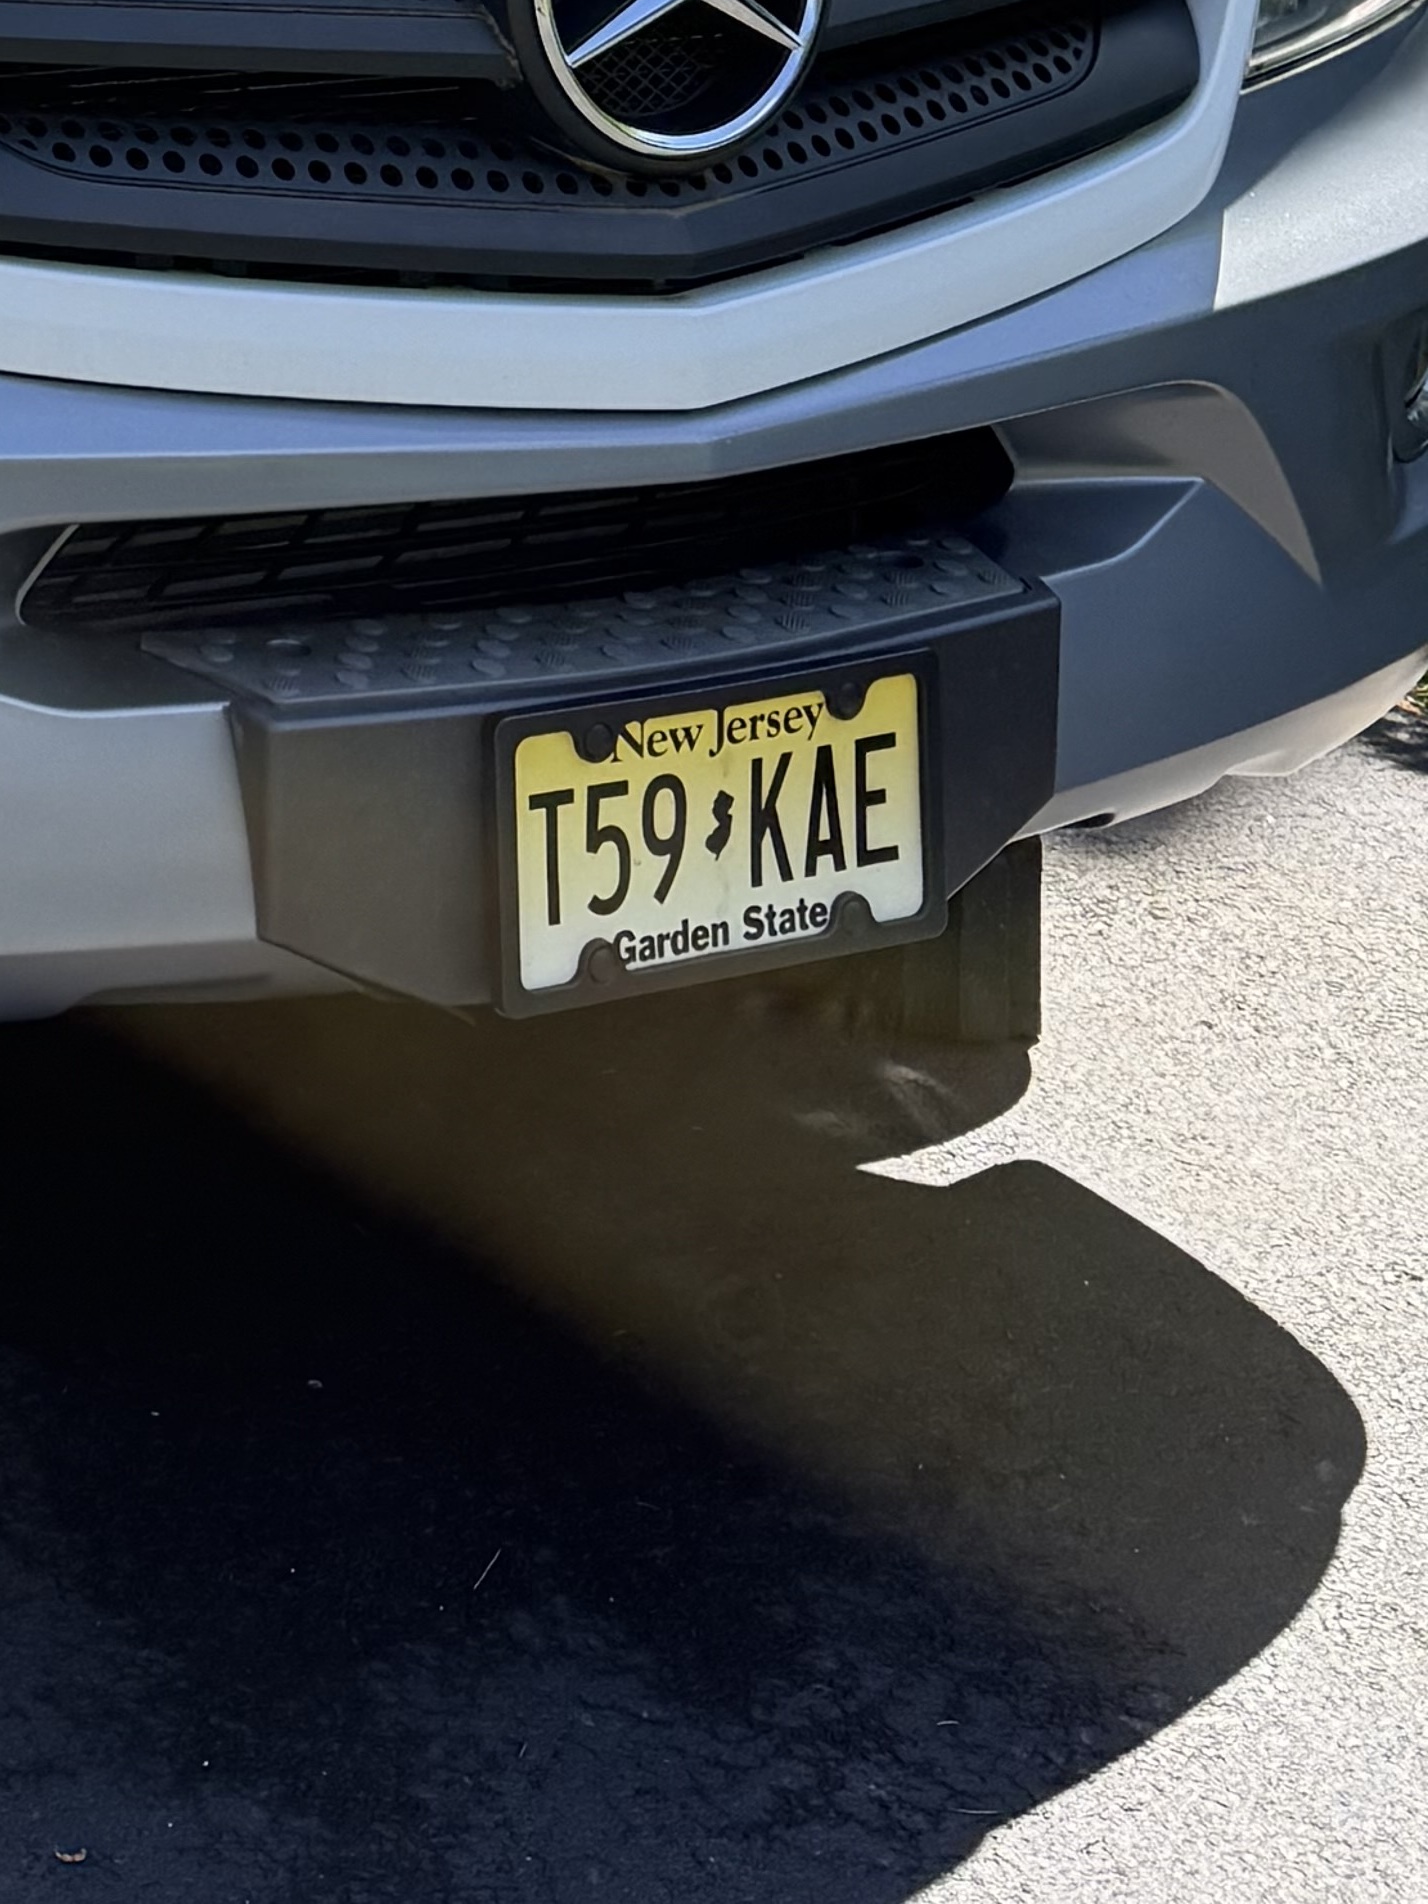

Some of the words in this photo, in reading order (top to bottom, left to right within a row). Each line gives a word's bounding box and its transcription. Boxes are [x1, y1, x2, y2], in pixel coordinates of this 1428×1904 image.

[611, 722, 704, 763] New
[709, 701, 825, 757] Jersey
[613, 918, 730, 966] Garden
[743, 898, 830, 941] State
